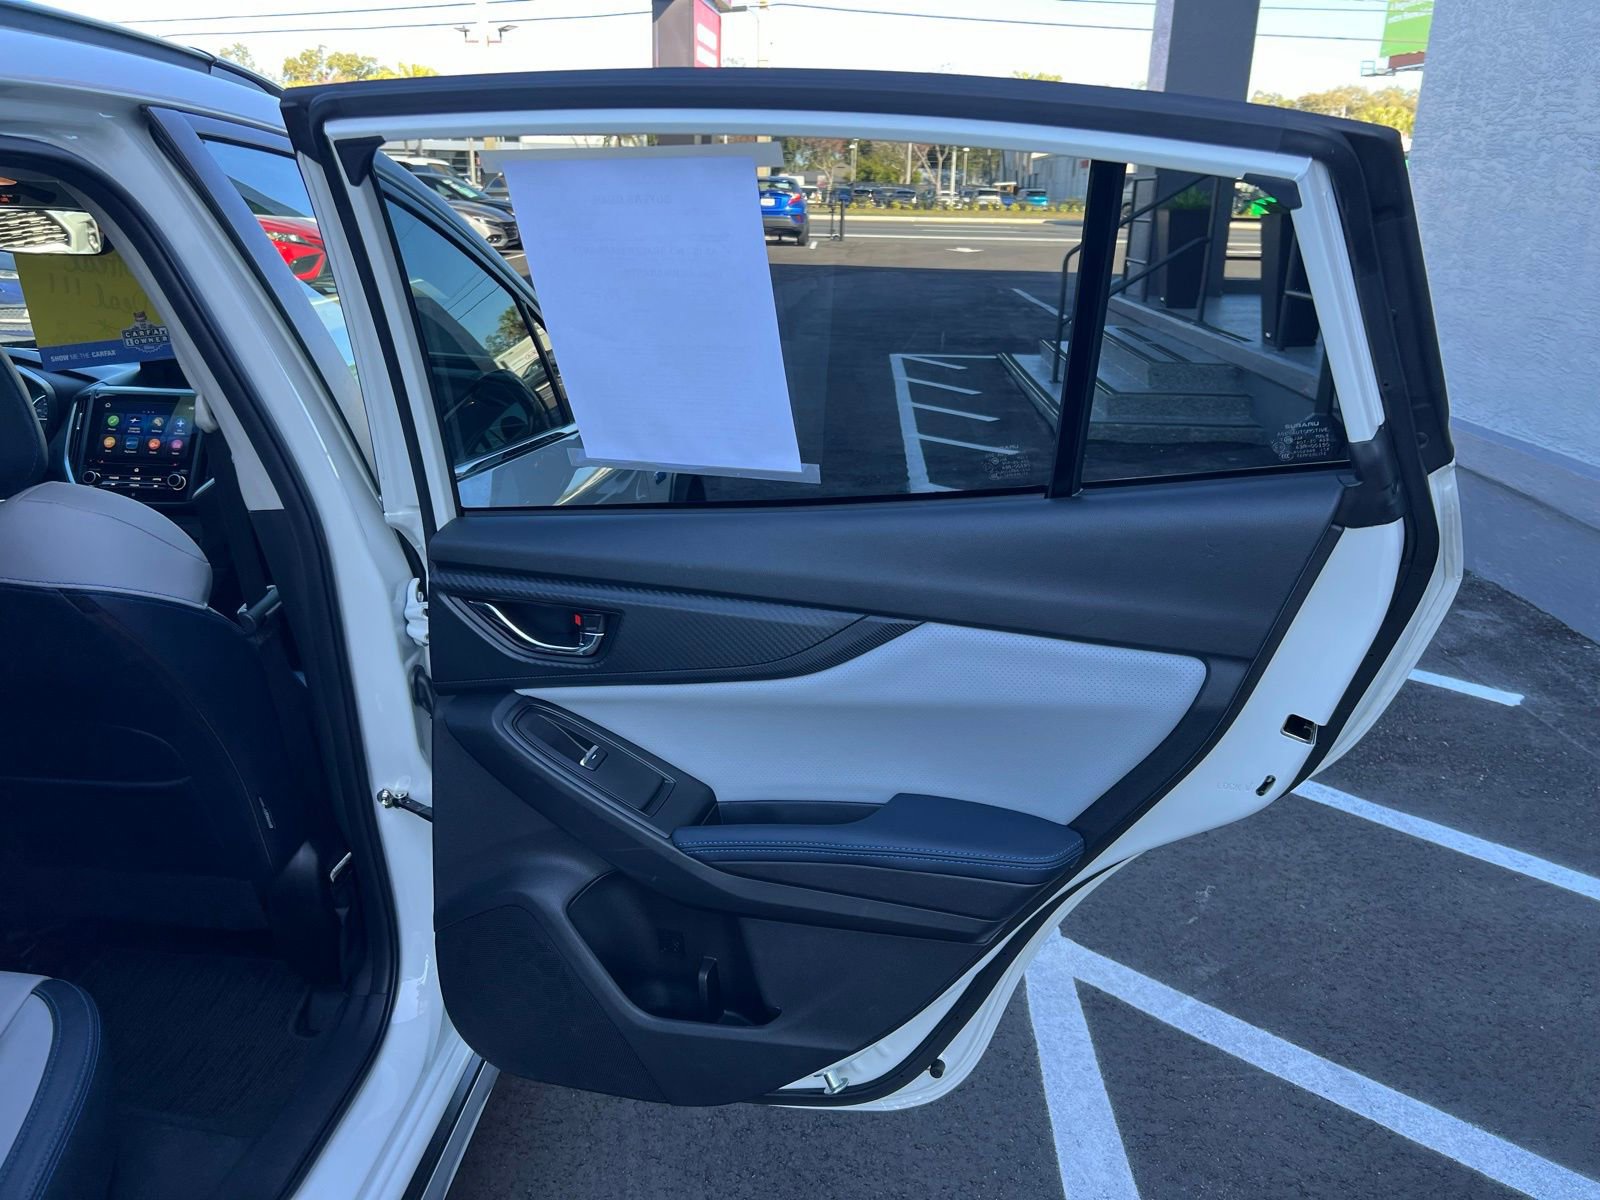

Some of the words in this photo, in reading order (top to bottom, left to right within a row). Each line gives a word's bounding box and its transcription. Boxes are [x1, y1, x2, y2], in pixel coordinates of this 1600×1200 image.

[50, 354, 69, 362] SHOW
[91, 350, 116, 358] CARFAX
[1284, 421, 1320, 430] SUBARU
